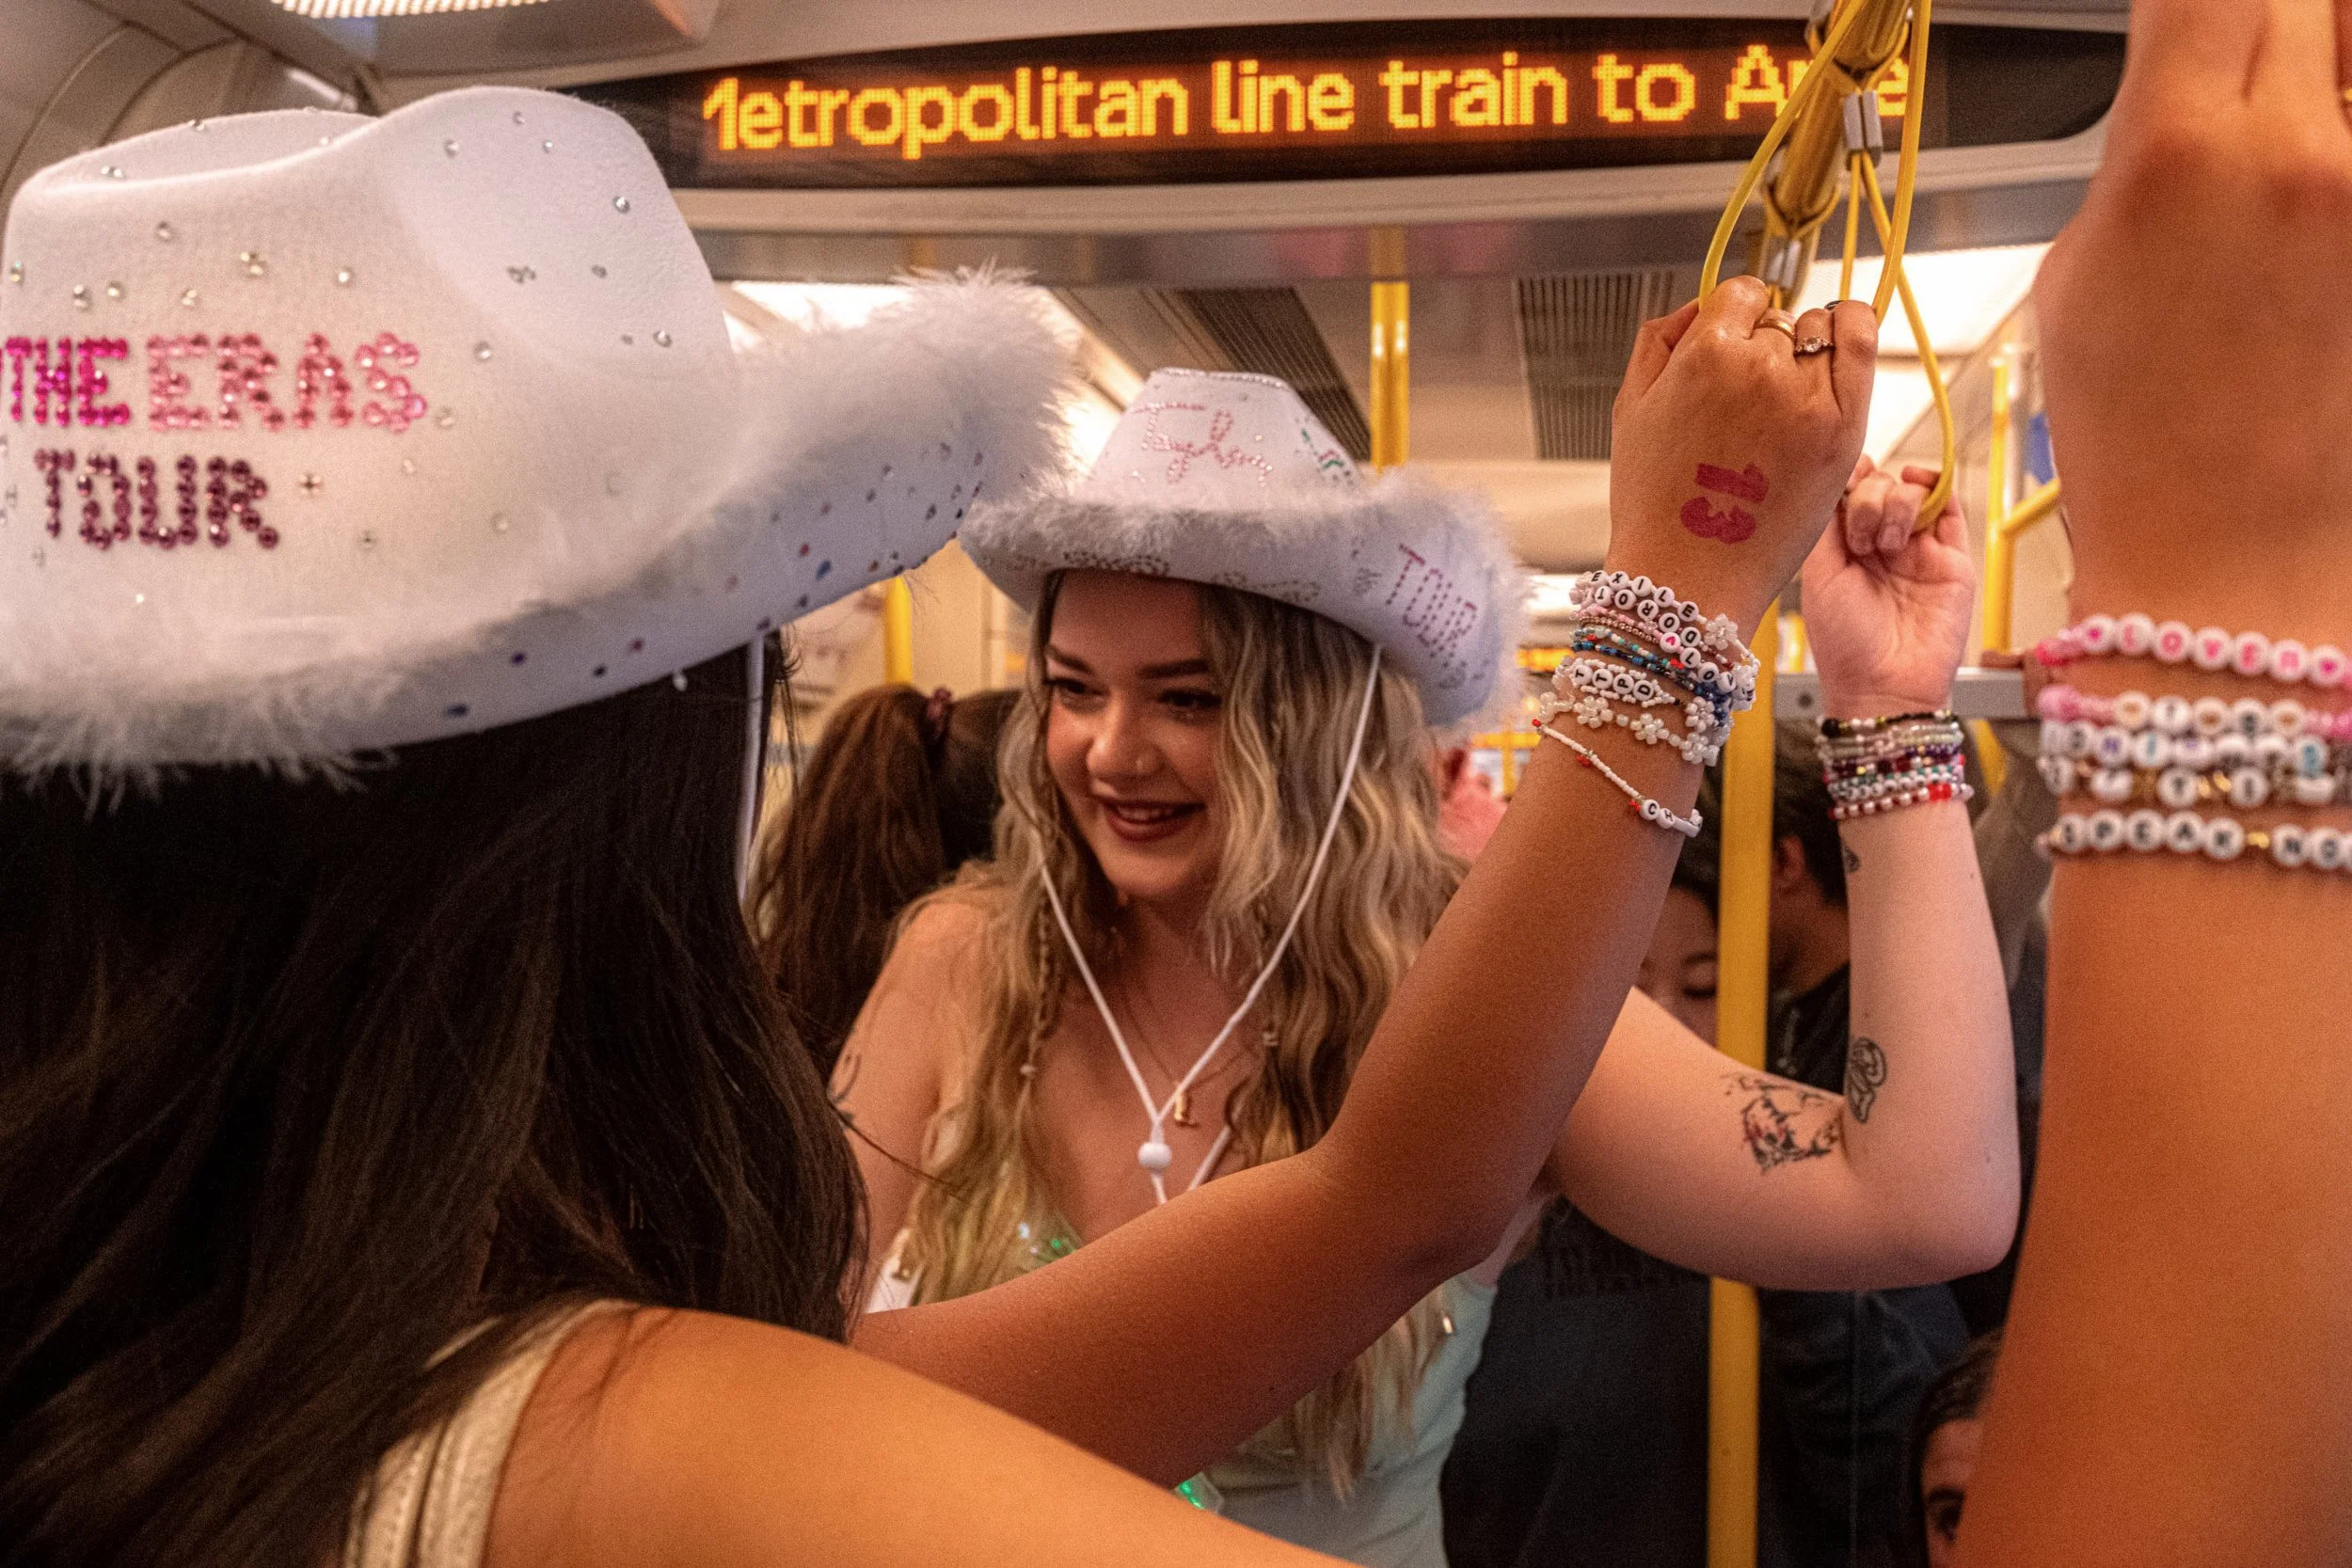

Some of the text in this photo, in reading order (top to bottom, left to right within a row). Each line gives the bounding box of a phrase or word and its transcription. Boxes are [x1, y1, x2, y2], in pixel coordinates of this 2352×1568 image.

[1211, 60, 1355, 134] line
[1379, 51, 1568, 129] train
[1592, 54, 1696, 124] to
[5, 331, 428, 434] THE ERAS
[34, 447, 280, 551] TOUR
[1680, 462, 1770, 546] 13
[1385, 542, 1479, 659] TOUR
[1590, 571, 1696, 620] EXILE
[1575, 669, 1652, 696] TTPD
